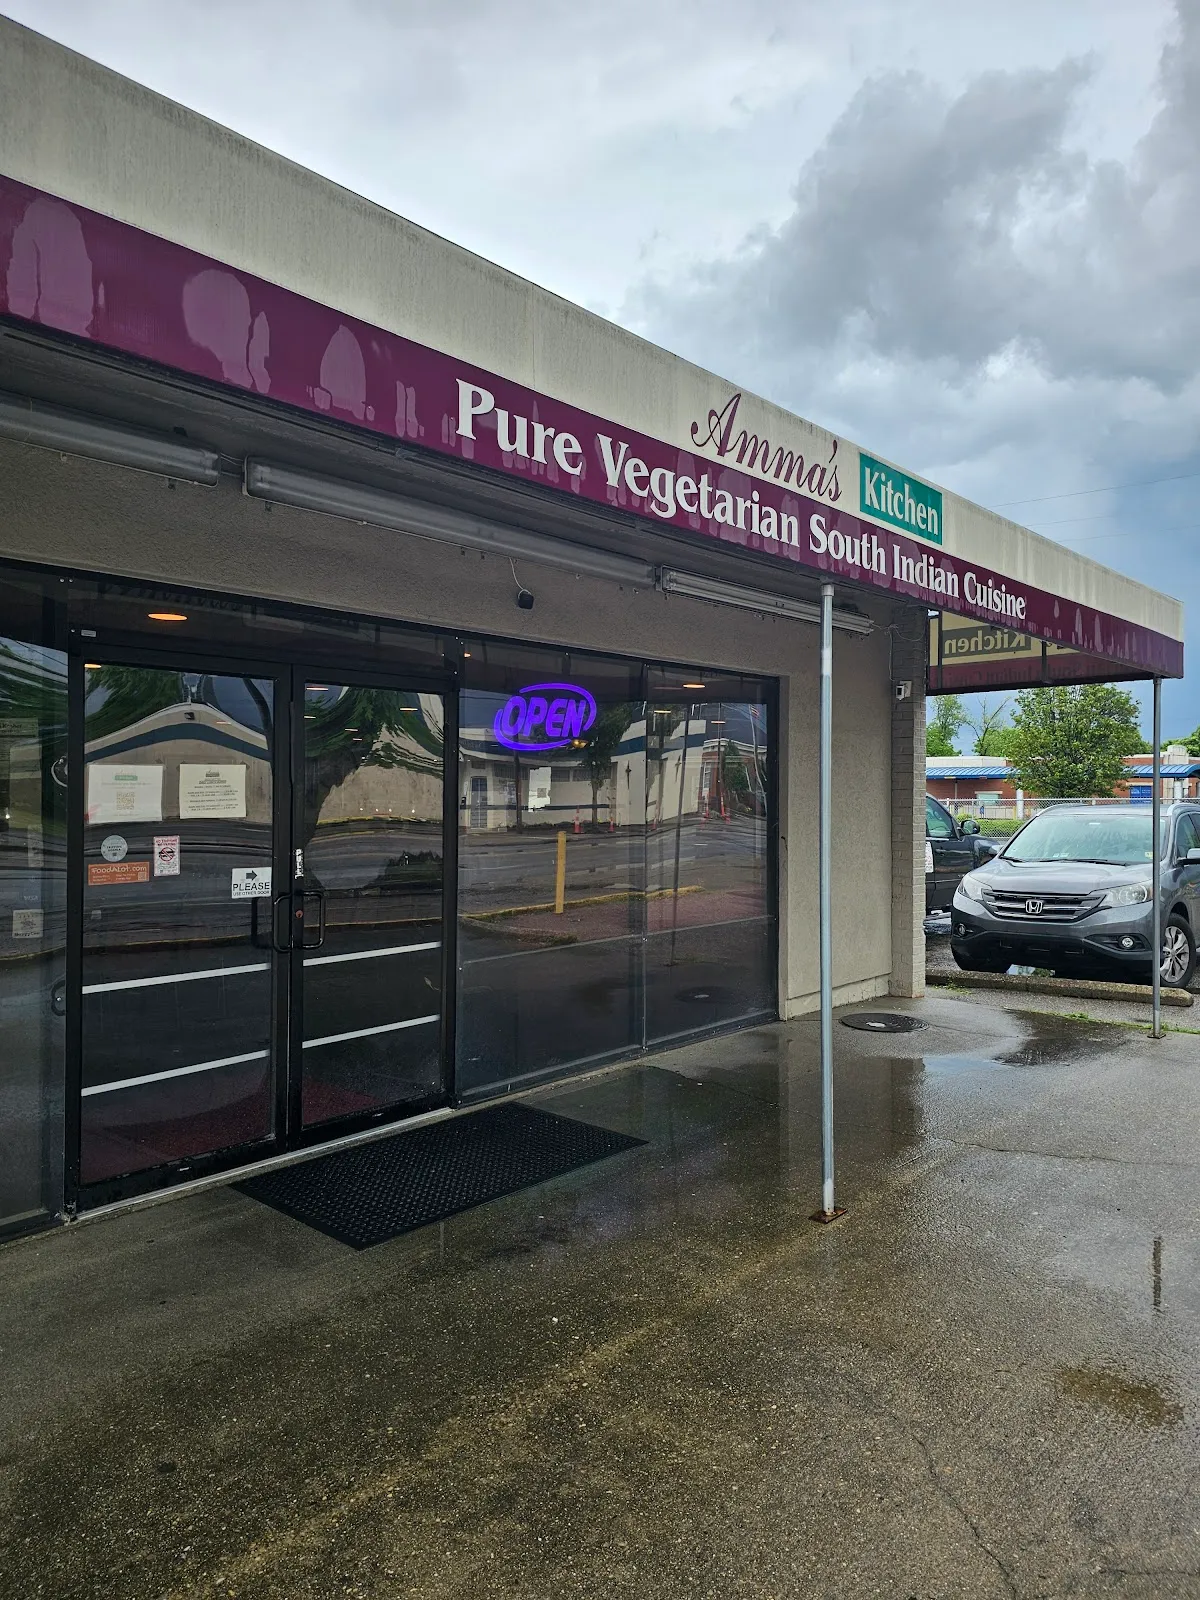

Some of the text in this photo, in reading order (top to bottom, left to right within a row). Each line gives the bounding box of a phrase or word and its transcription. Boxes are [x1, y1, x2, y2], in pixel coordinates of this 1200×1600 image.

[690, 393, 842, 502] Amma's
[455, 378, 1026, 620] Pure Vegetarian South Indian Cuisine
[864, 466, 939, 536] Kitchen
[501, 695, 586, 738] OPEN
[232, 881, 270, 892] PLEASE
